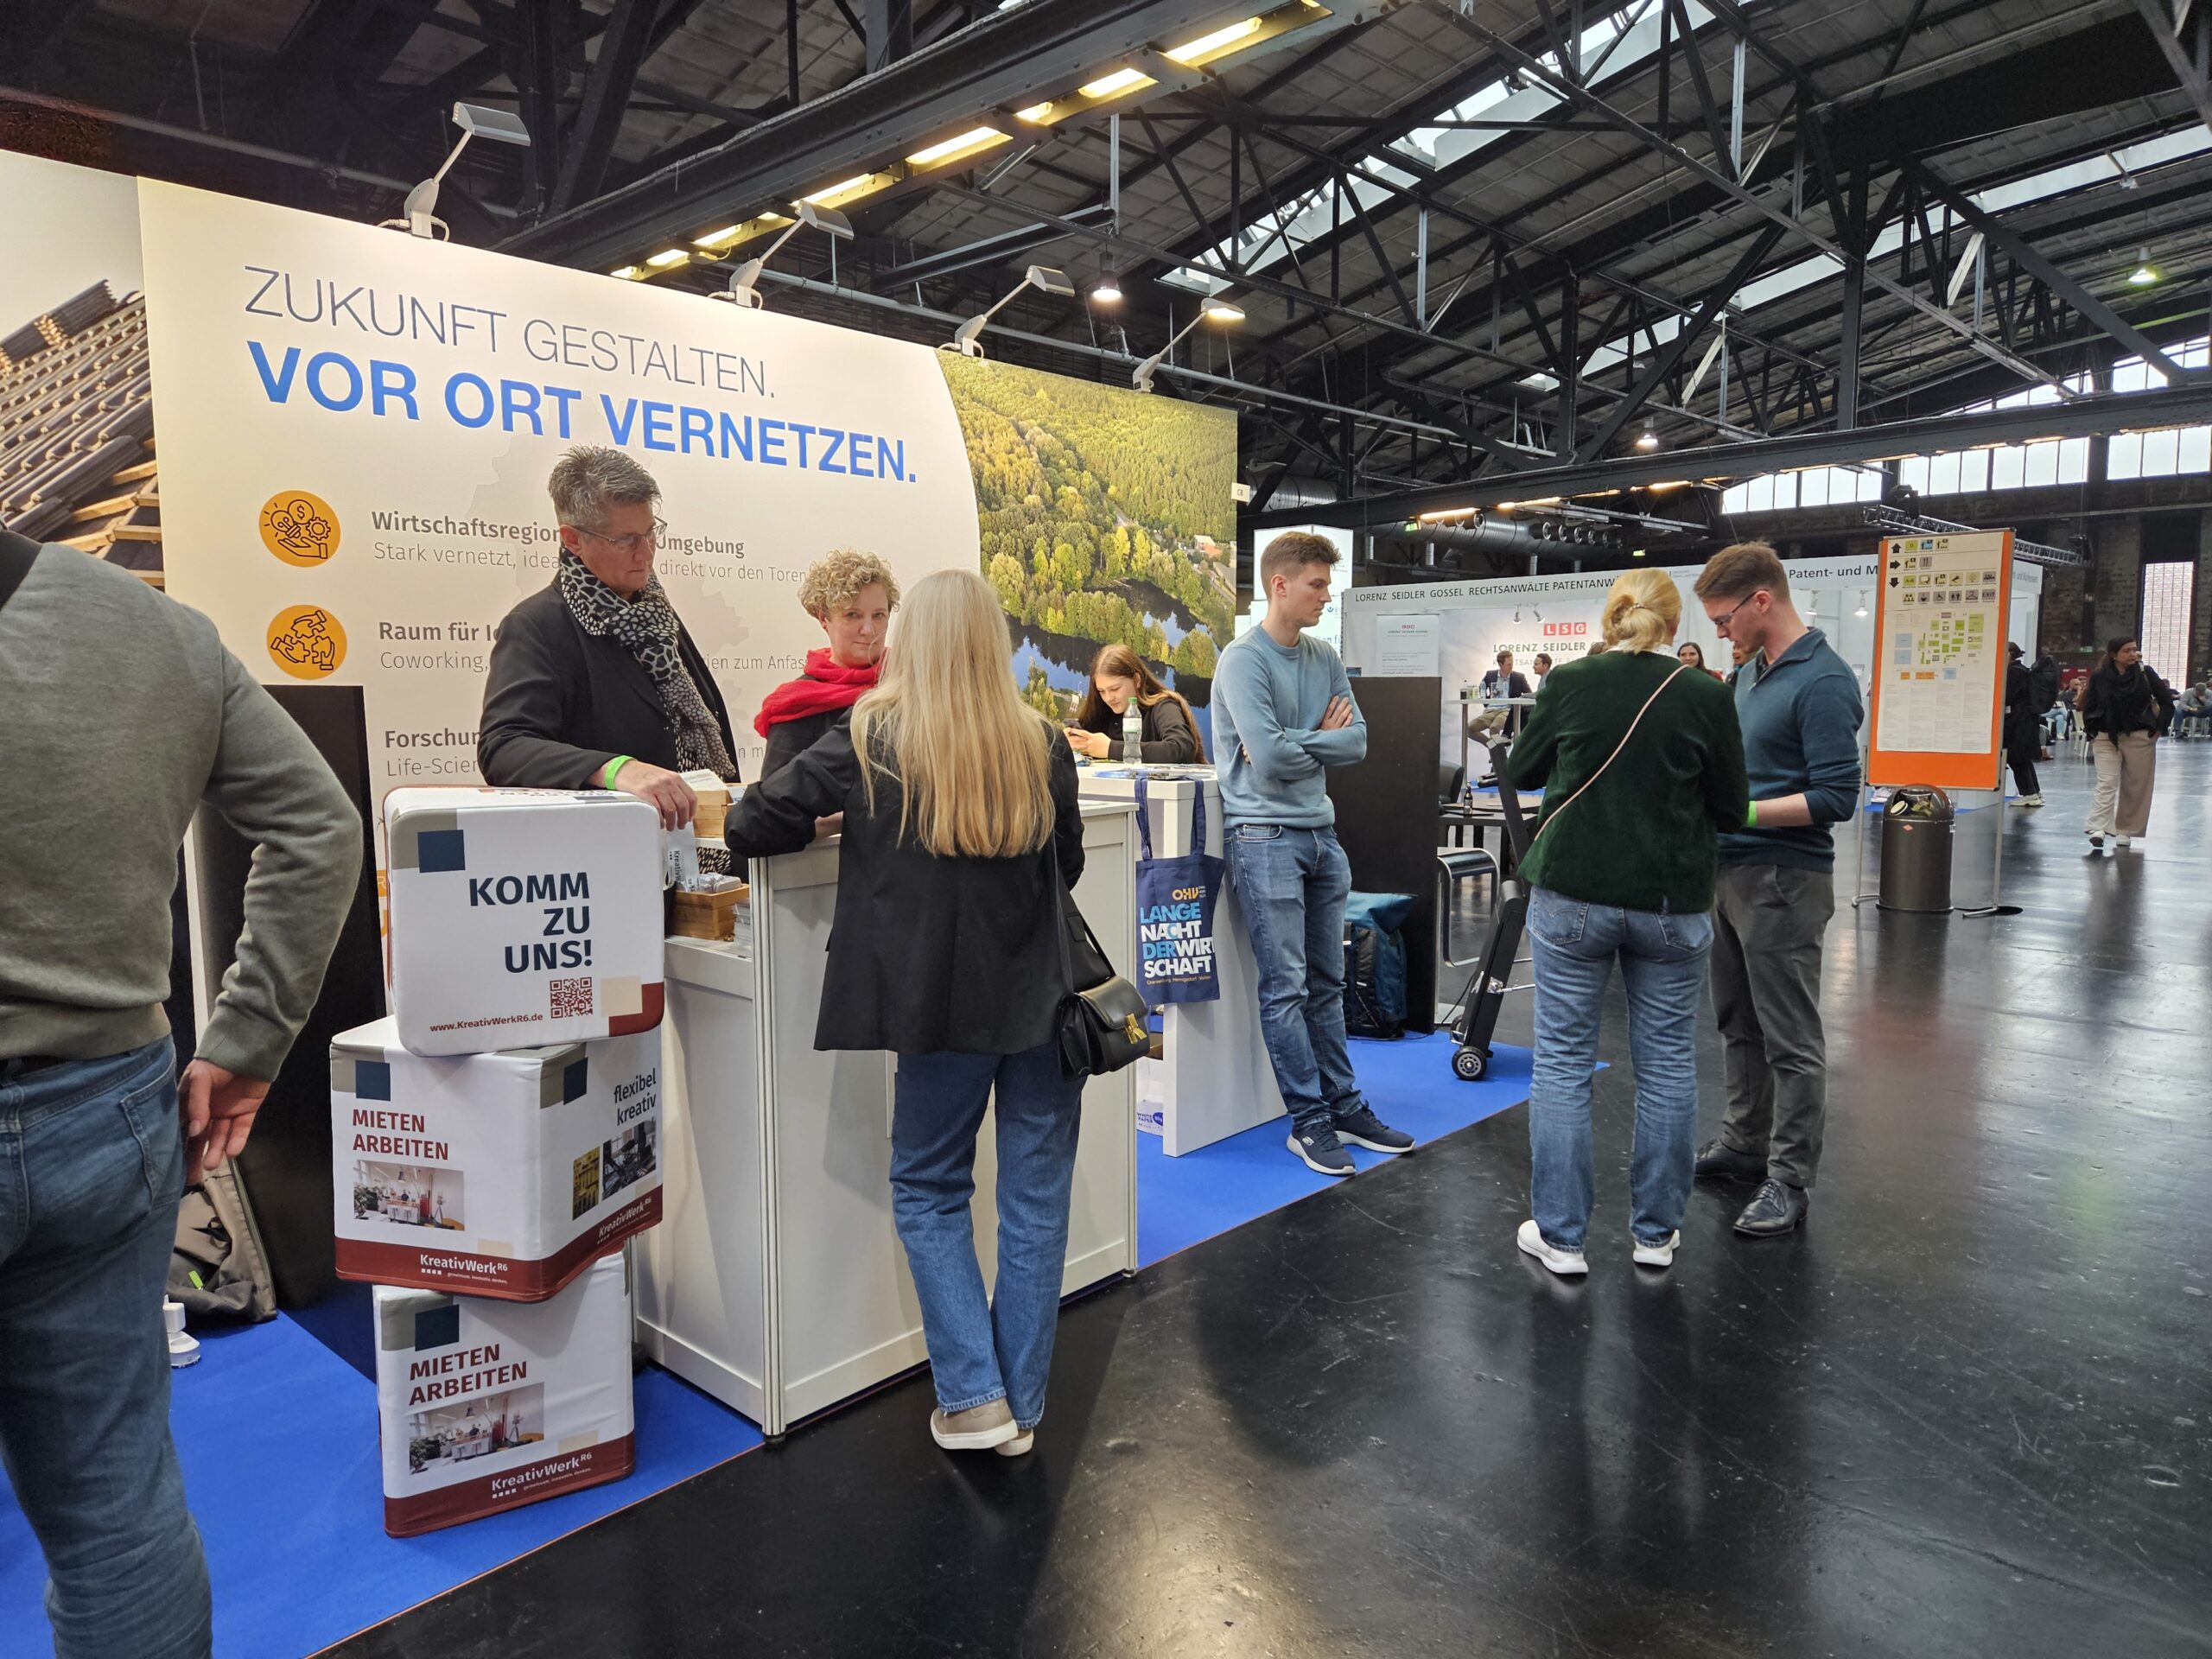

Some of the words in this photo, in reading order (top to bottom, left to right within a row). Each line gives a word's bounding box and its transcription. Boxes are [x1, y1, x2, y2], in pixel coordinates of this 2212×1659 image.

[245, 265, 507, 353] ZUKUNFT
[524, 319, 775, 398] GESTALTEN.
[246, 340, 420, 421] VOR
[444, 372, 583, 440] ORT
[600, 393, 918, 484] VERNETZEN.
[373, 542, 427, 562] Stark
[433, 549, 517, 570] vernetzt,
[523, 550, 561, 569] idea
[659, 559, 705, 577] direkt
[709, 565, 733, 578] vor
[737, 564, 764, 580] den
[767, 566, 806, 582] Toren
[1789, 568, 1834, 579] Patent-
[1837, 565, 1861, 576] und
[1355, 593, 1387, 602] LORENZ
[1392, 590, 1425, 601] SEIDLER
[1430, 588, 1464, 598] GOSSEL
[1469, 582, 1549, 596] RECHTSANWÄLTE
[1553, 577, 1617, 591] PATENTANW
[379, 622, 441, 640] Raum
[448, 622, 480, 641] für
[1493, 644, 1538, 652] LORENZ
[1543, 642, 1586, 652] SEIDLER
[380, 651, 488, 673] Coworking,
[734, 658, 763, 670] zum
[767, 654, 807, 670] Anfas
[385, 728, 480, 748] Forschun
[469, 872, 590, 906] KOMM
[543, 906, 590, 936] ZU
[1140, 902, 1202, 924] LANGE
[1141, 920, 1202, 942] NACHT
[505, 939, 593, 973] UNS!
[1144, 956, 1211, 978] SCHAFT
[429, 1013, 543, 1033] www.KreativWerkR6.de
[613, 1067, 656, 1103] flexibel
[353, 1109, 425, 1133] MIETEN
[617, 1091, 656, 1126] kreativ
[353, 1134, 448, 1160] ARBEITEN
[410, 1344, 500, 1381] MIETEN
[409, 1361, 527, 1406] ARBEITEN
